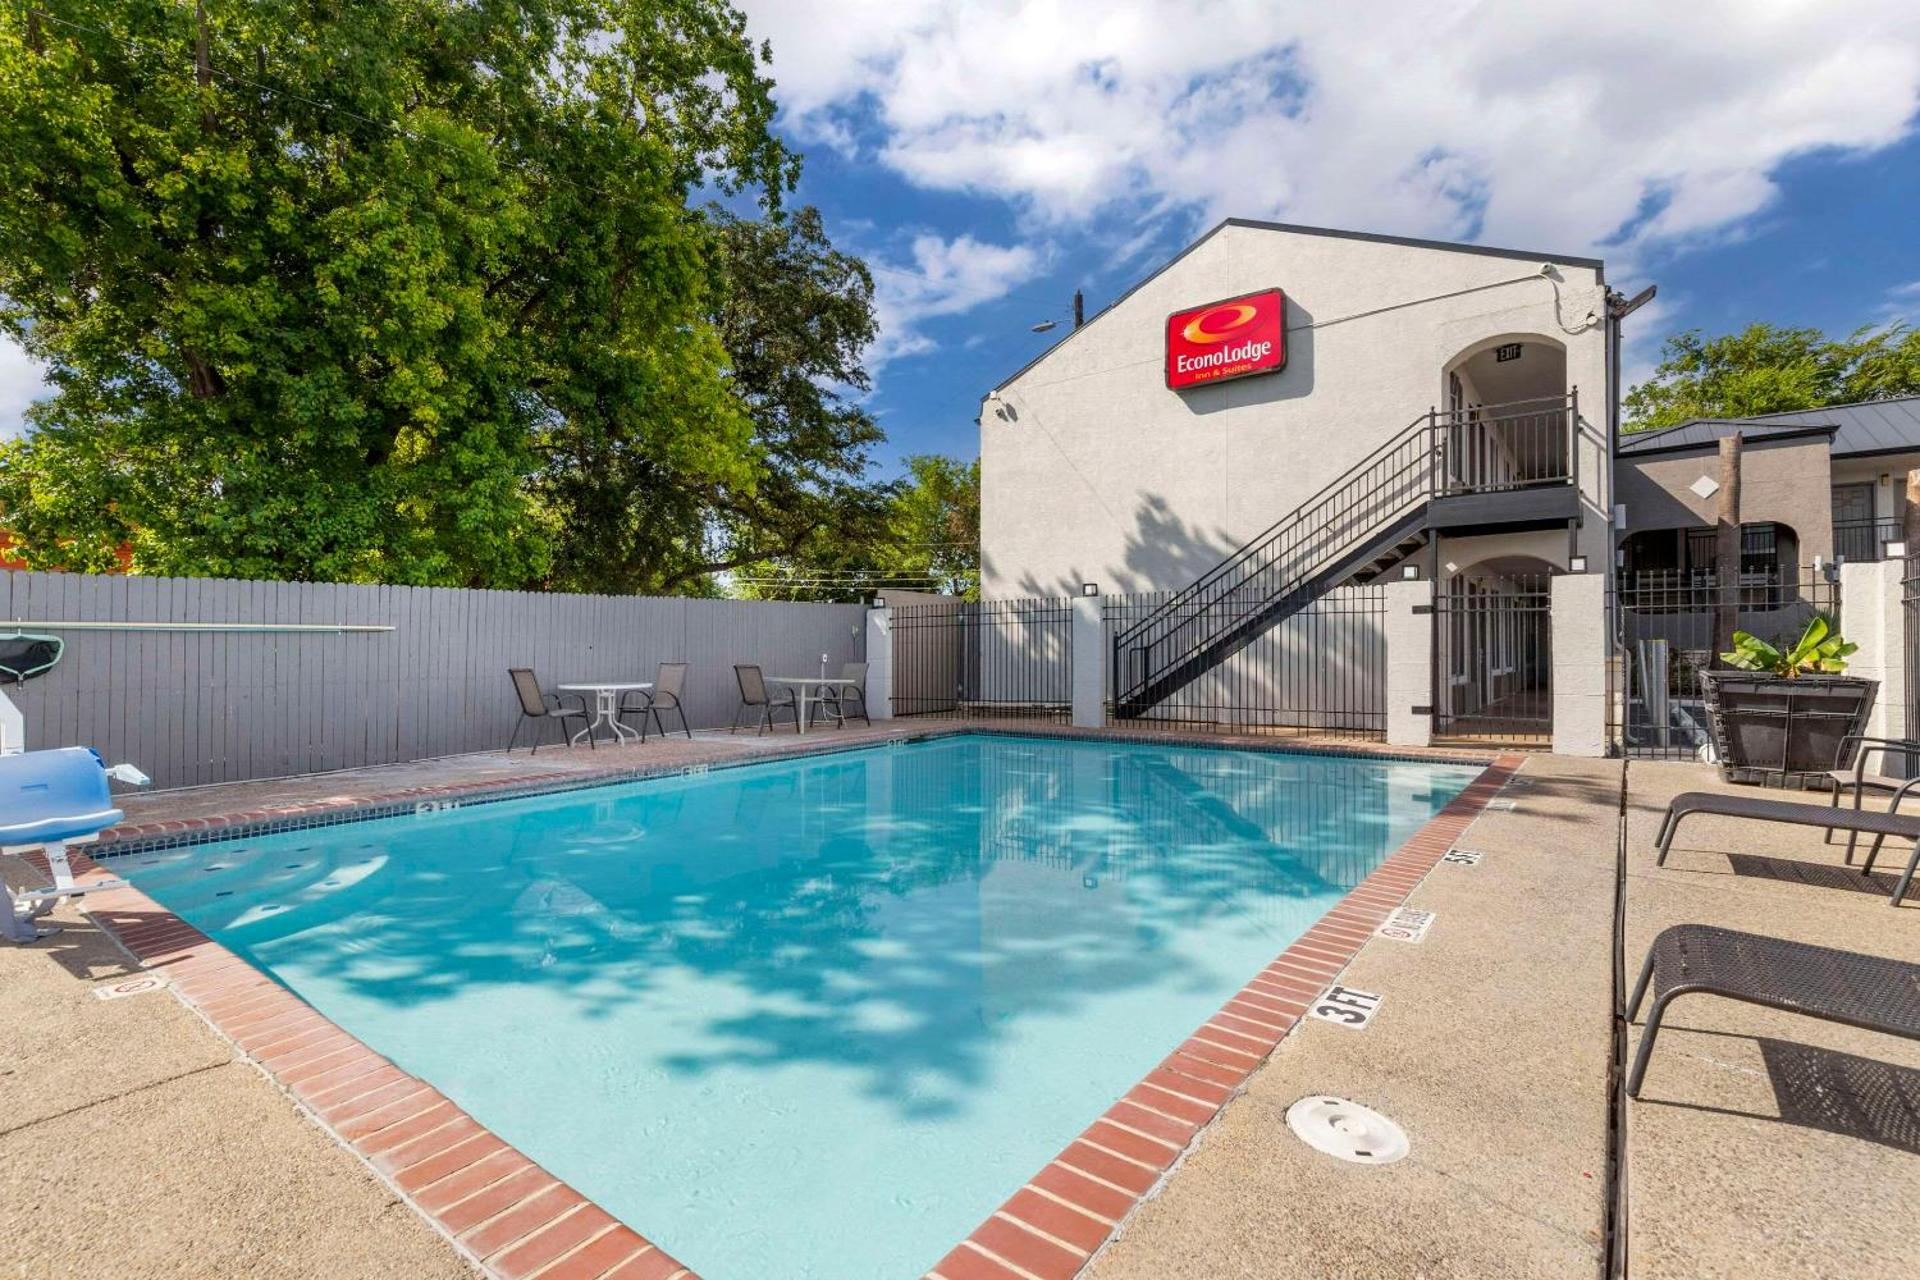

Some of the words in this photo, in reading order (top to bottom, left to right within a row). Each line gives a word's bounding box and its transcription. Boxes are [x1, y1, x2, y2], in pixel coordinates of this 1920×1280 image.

[1500, 345, 1519, 360] EXIT
[1212, 368, 1220, 377] &
[1222, 363, 1253, 376] Suites
